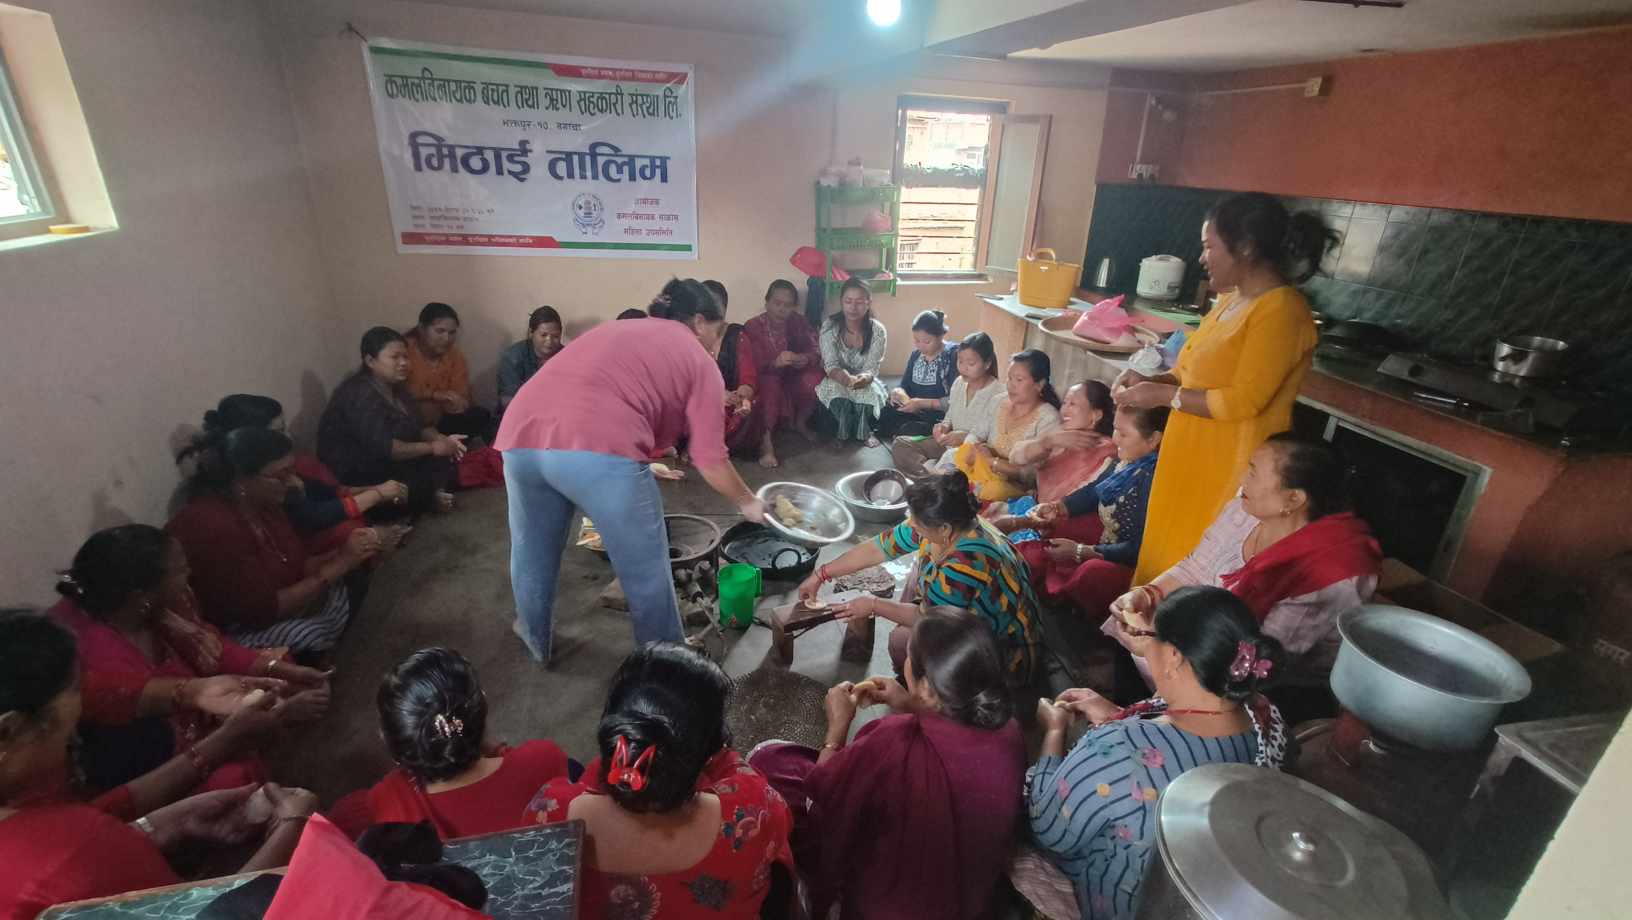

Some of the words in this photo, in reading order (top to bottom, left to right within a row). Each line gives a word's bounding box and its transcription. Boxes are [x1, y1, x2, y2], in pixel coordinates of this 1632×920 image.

[481, 82, 510, 108] बचत
[514, 85, 540, 109] तथा
[544, 87, 572, 112] ऋण
[576, 85, 625, 116] सहकारी
[628, 89, 660, 118] संस्था
[663, 86, 682, 120] लि.
[409, 130, 533, 182] मिठाई
[546, 141, 671, 183] तालिम
